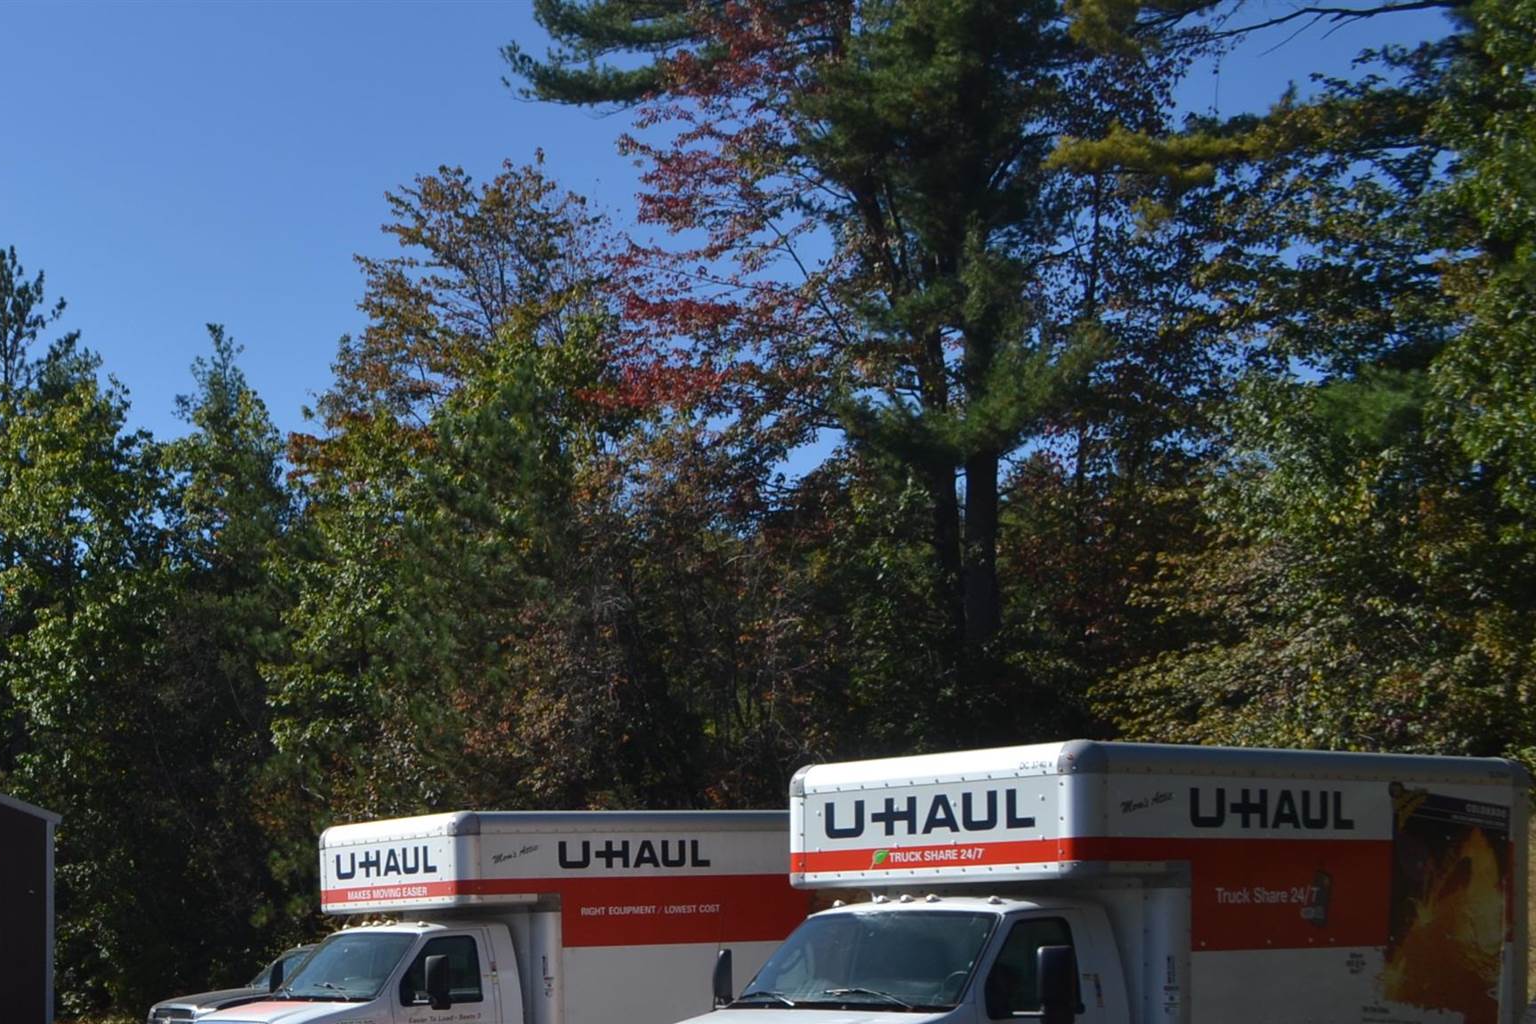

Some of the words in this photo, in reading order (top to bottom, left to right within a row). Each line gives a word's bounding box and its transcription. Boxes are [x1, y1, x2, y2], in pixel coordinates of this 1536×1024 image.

[824, 788, 1035, 840] U-HAUL
[1189, 787, 1355, 831] U-HAUL
[335, 845, 437, 880] U-HAUL
[557, 839, 711, 869] U-HAUL
[889, 850, 923, 864] TRUCK
[924, 849, 959, 862] SHARE
[960, 848, 985, 860] 24/7
[347, 890, 372, 901] MAKES
[372, 888, 401, 899] MOVING
[402, 886, 428, 898] EASIER
[1215, 887, 1250, 904] Truck
[1253, 887, 1288, 904] Share
[580, 906, 606, 917] RIGHT
[608, 905, 656, 916] EQUIPMENT
[664, 904, 697, 914] LOWEST
[699, 903, 721, 913] COST
